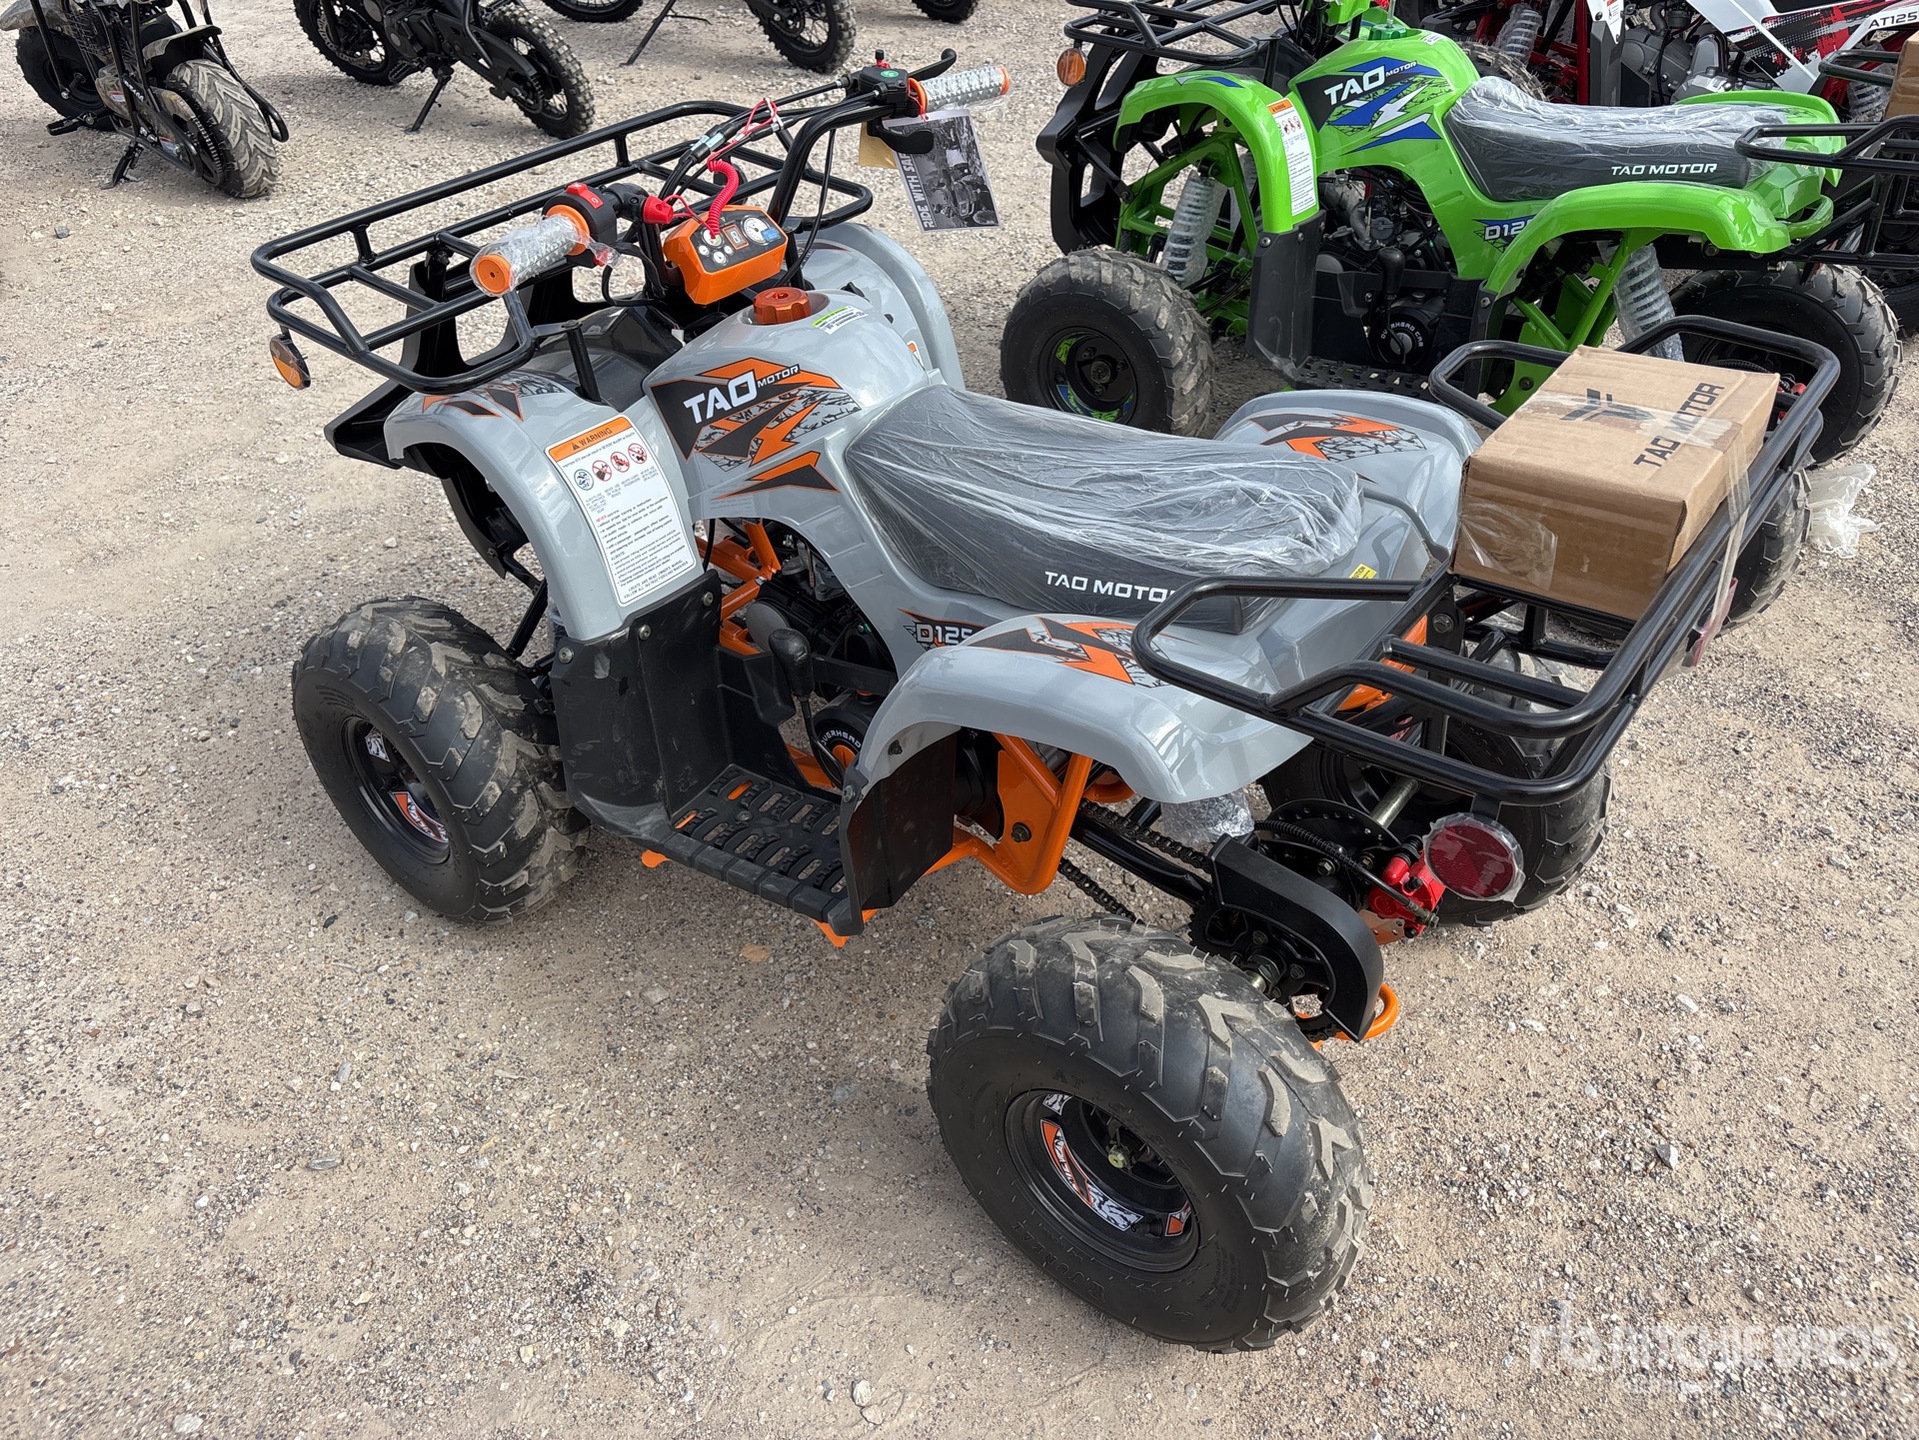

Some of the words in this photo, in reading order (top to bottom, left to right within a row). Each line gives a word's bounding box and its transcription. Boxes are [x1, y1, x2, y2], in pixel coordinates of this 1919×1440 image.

[1868, 10, 1918, 29] AT125
[1323, 65, 1385, 106] TAO
[1385, 61, 1417, 77] MOTOR
[1611, 165, 1645, 176] TAO
[1648, 163, 1718, 175] MOTOR
[906, 175, 926, 203] WITH
[917, 205, 935, 228] RIDE
[1484, 219, 1532, 240] D12
[1380, 321, 1416, 339] OVRHEAD
[683, 371, 757, 424] TAO
[757, 365, 799, 388] MOTOR
[1633, 435, 1681, 468] TAO
[1665, 382, 1726, 434] MOTOR
[579, 428, 613, 447] WARNING
[1045, 571, 1089, 591] TAO
[1093, 579, 1176, 603] MOTO
[916, 623, 973, 644] D125
